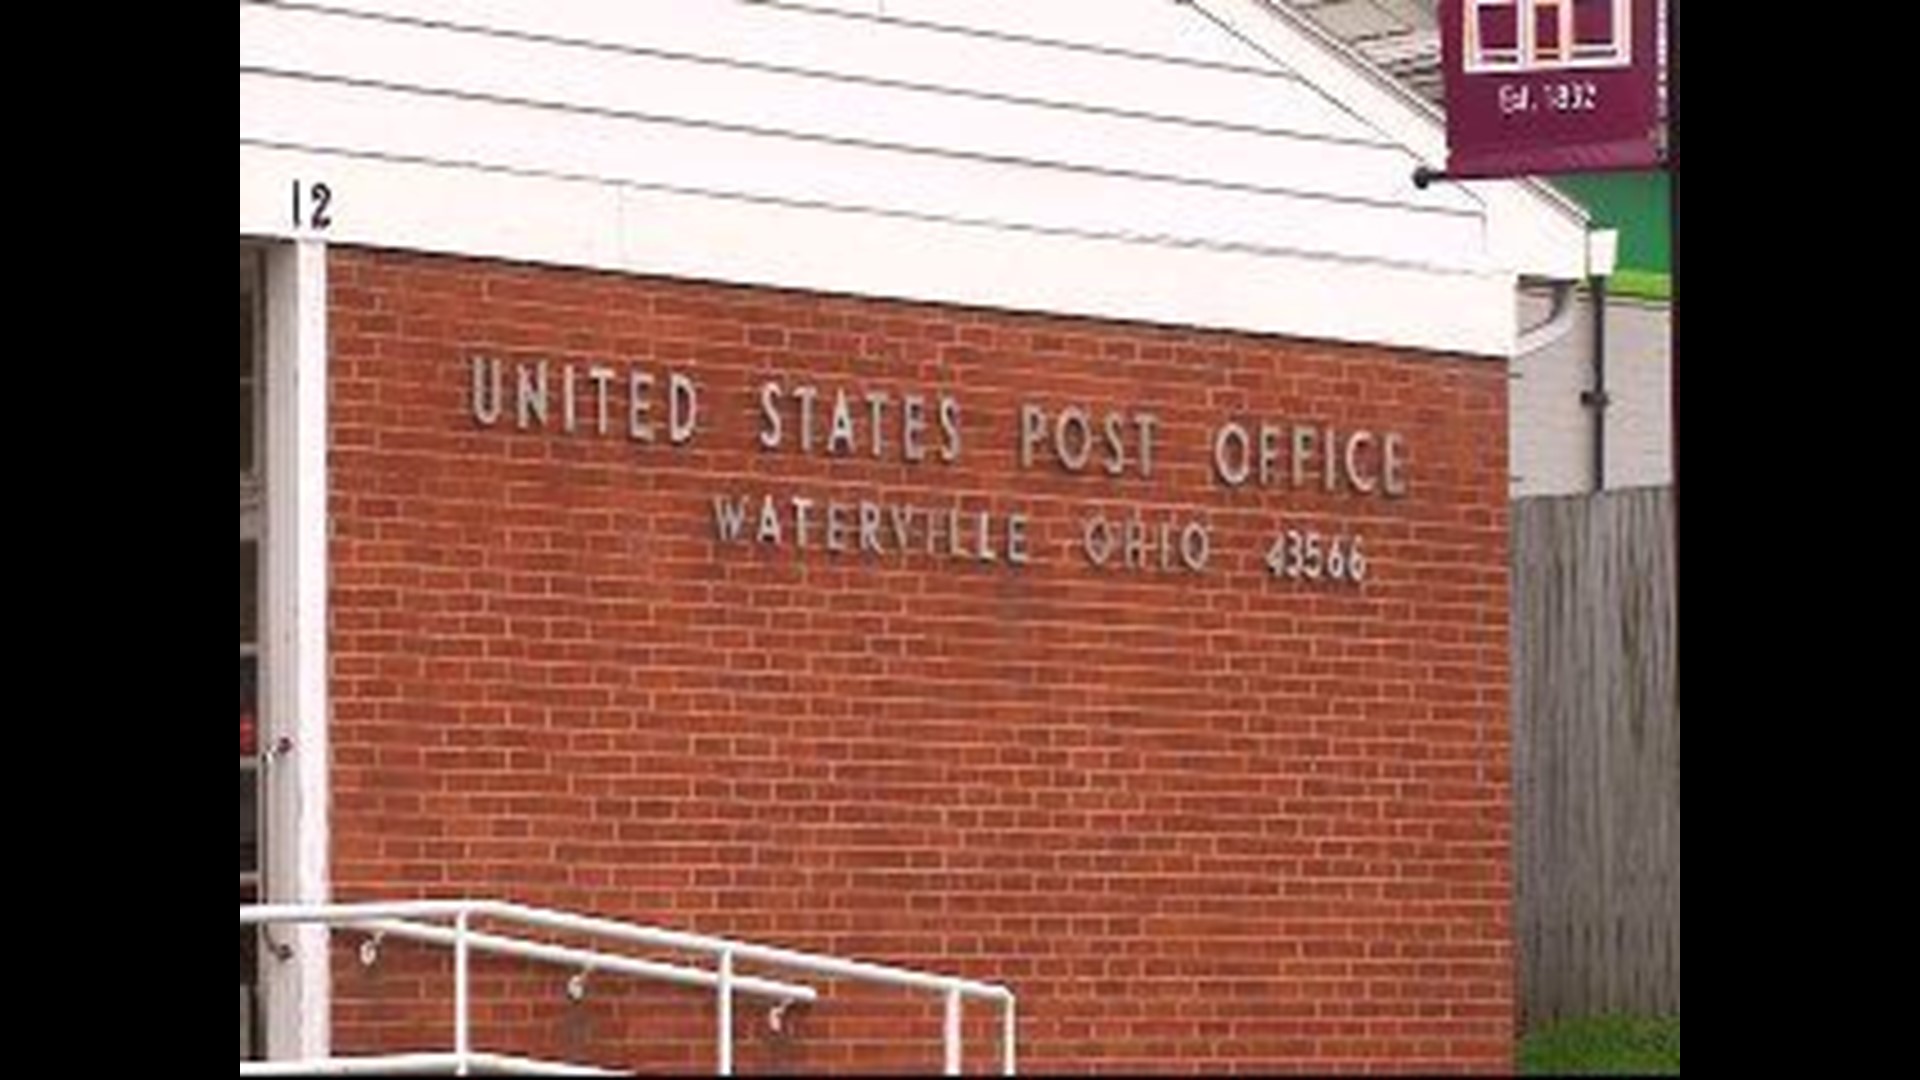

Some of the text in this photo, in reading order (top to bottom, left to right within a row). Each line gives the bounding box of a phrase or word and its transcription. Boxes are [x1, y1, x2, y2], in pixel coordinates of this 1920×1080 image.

[292, 179, 332, 230] 12
[471, 357, 1407, 495] UNITED STATES POST OFFICE
[713, 496, 1368, 581] WATERVILLE OHIO 43566
